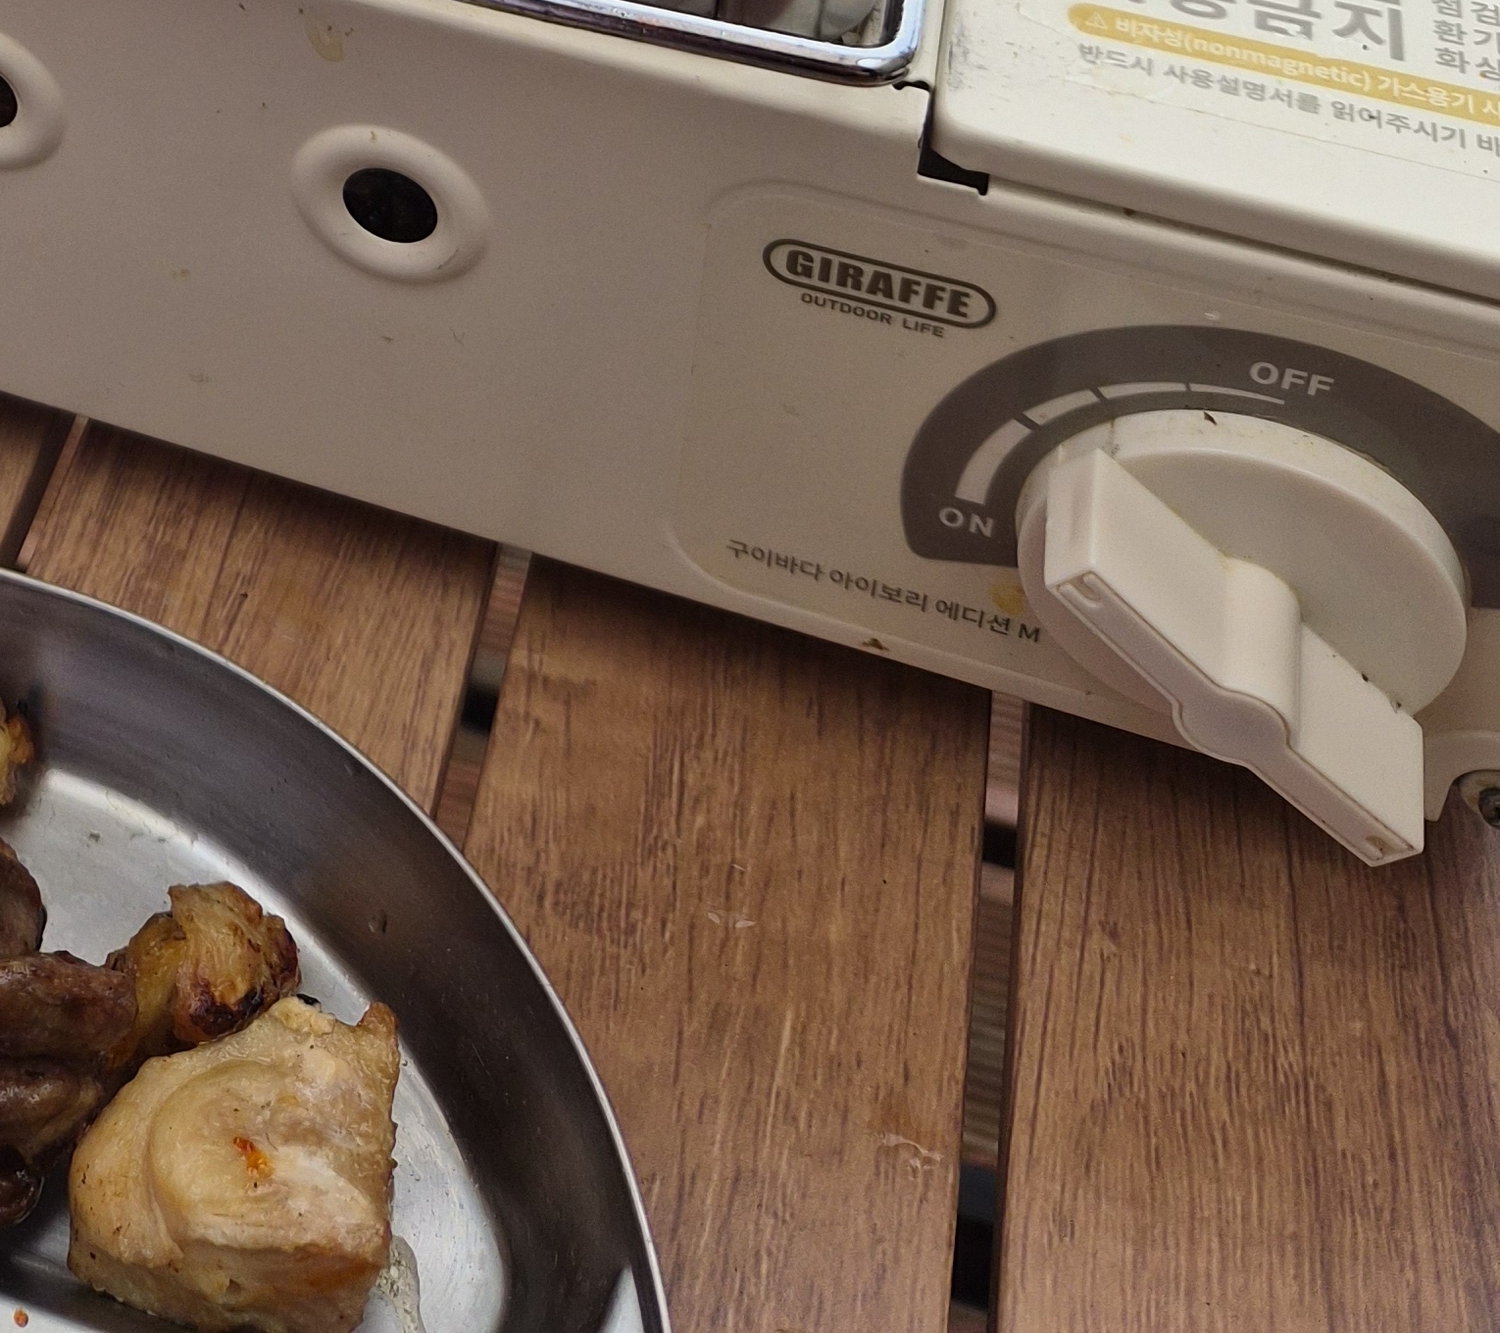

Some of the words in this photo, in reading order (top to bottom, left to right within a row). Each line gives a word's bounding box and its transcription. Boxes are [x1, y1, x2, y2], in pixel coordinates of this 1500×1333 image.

[1079, 43, 1154, 76] 반드시
[1163, 65, 1322, 115] 사용설명서를
[1331, 101, 1466, 149] 읽어주시기
[1377, 75, 1474, 114] 가스용기
[786, 249, 972, 318] GIRAFFE
[801, 292, 893, 325] OUTDOOR
[902, 318, 945, 338] LIFE
[1249, 362, 1335, 396] OFF
[939, 507, 994, 538] ON
[726, 539, 823, 581] 구이바다
[829, 568, 929, 612] 아이보리
[935, 597, 1012, 636] 에디션
[1018, 623, 1041, 643] M
